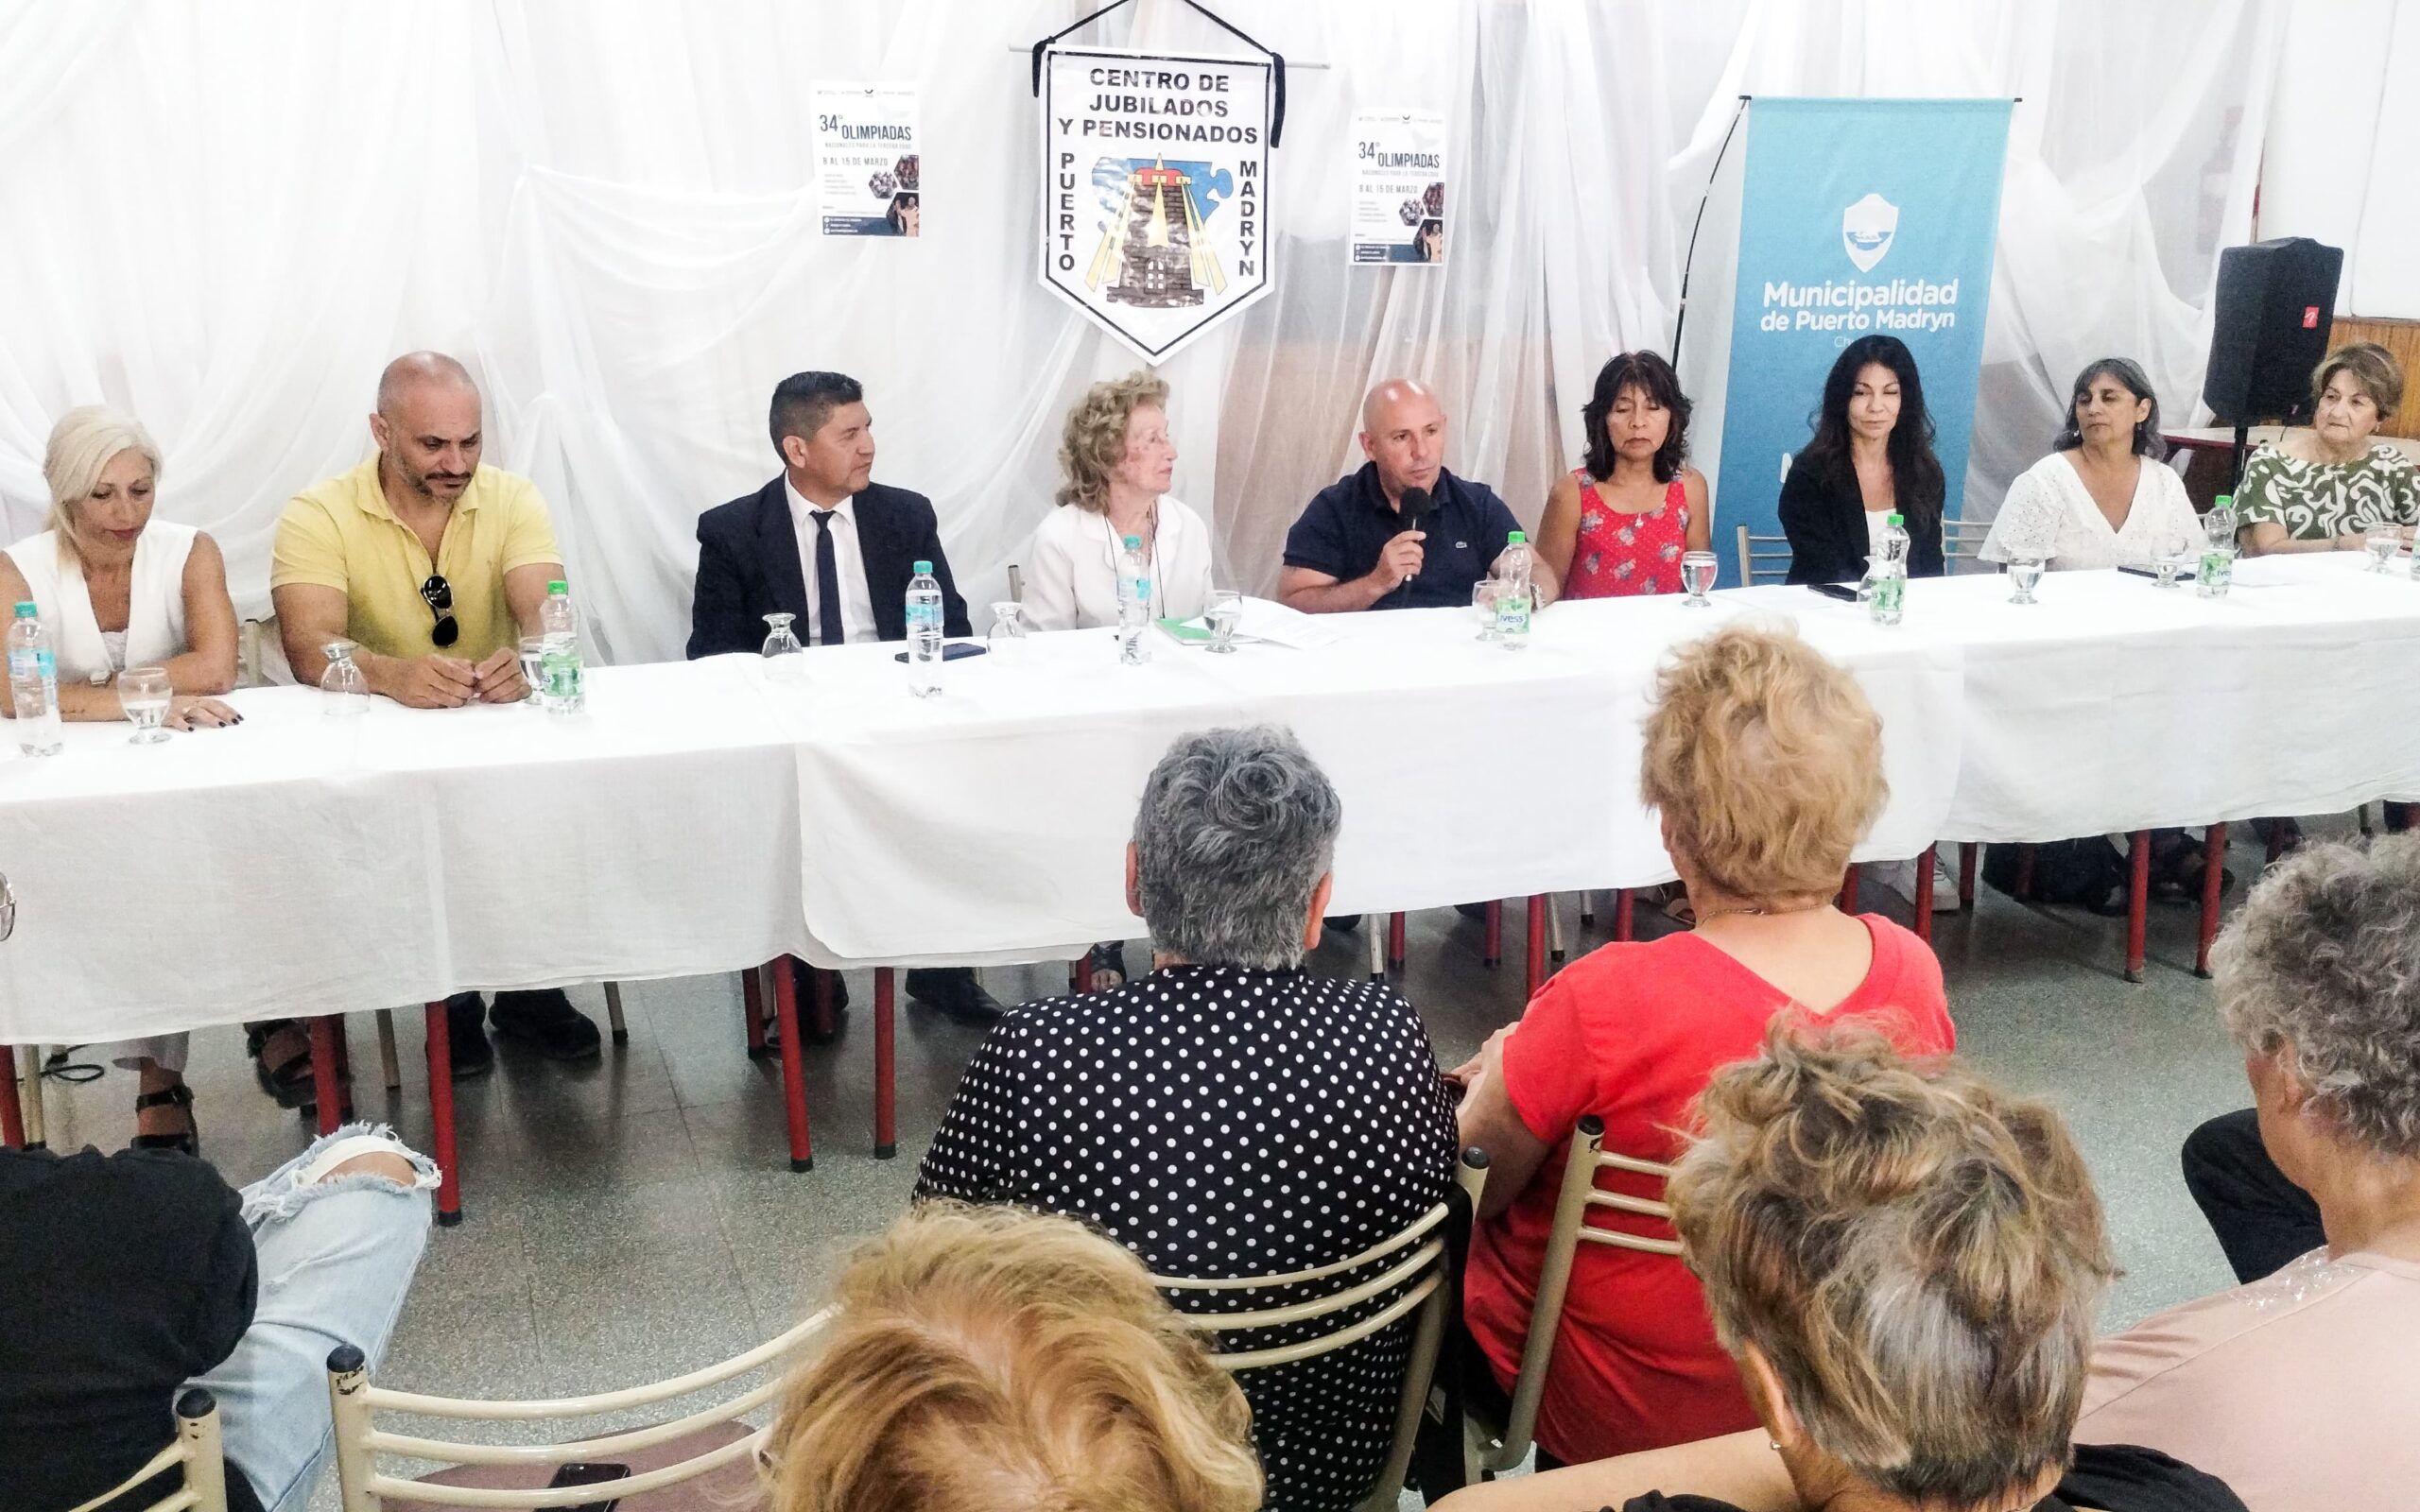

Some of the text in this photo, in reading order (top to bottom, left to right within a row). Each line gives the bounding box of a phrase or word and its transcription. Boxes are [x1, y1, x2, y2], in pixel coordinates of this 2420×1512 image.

[1090, 68, 1230, 93] CENTRO DE
[1089, 94, 1229, 118] JUBILADOS
[841, 125, 912, 141] OLIMPIADAS
[1058, 118, 1258, 144] Y PENSIONADOS
[830, 157, 838, 165] AL
[842, 157, 851, 165] 15
[852, 157, 862, 165] DE
[864, 157, 889, 166] MARZO
[1377, 152, 1440, 168] OLIMPIADAS
[1385, 185, 1393, 194] DE
[1396, 185, 1418, 194] MARZO
[1060, 152, 1076, 271] PUERTO
[1238, 161, 1257, 276] MADRYN
[1763, 278, 1959, 311] Municipalidad
[1760, 308, 1956, 333] de Puerto Madryn
